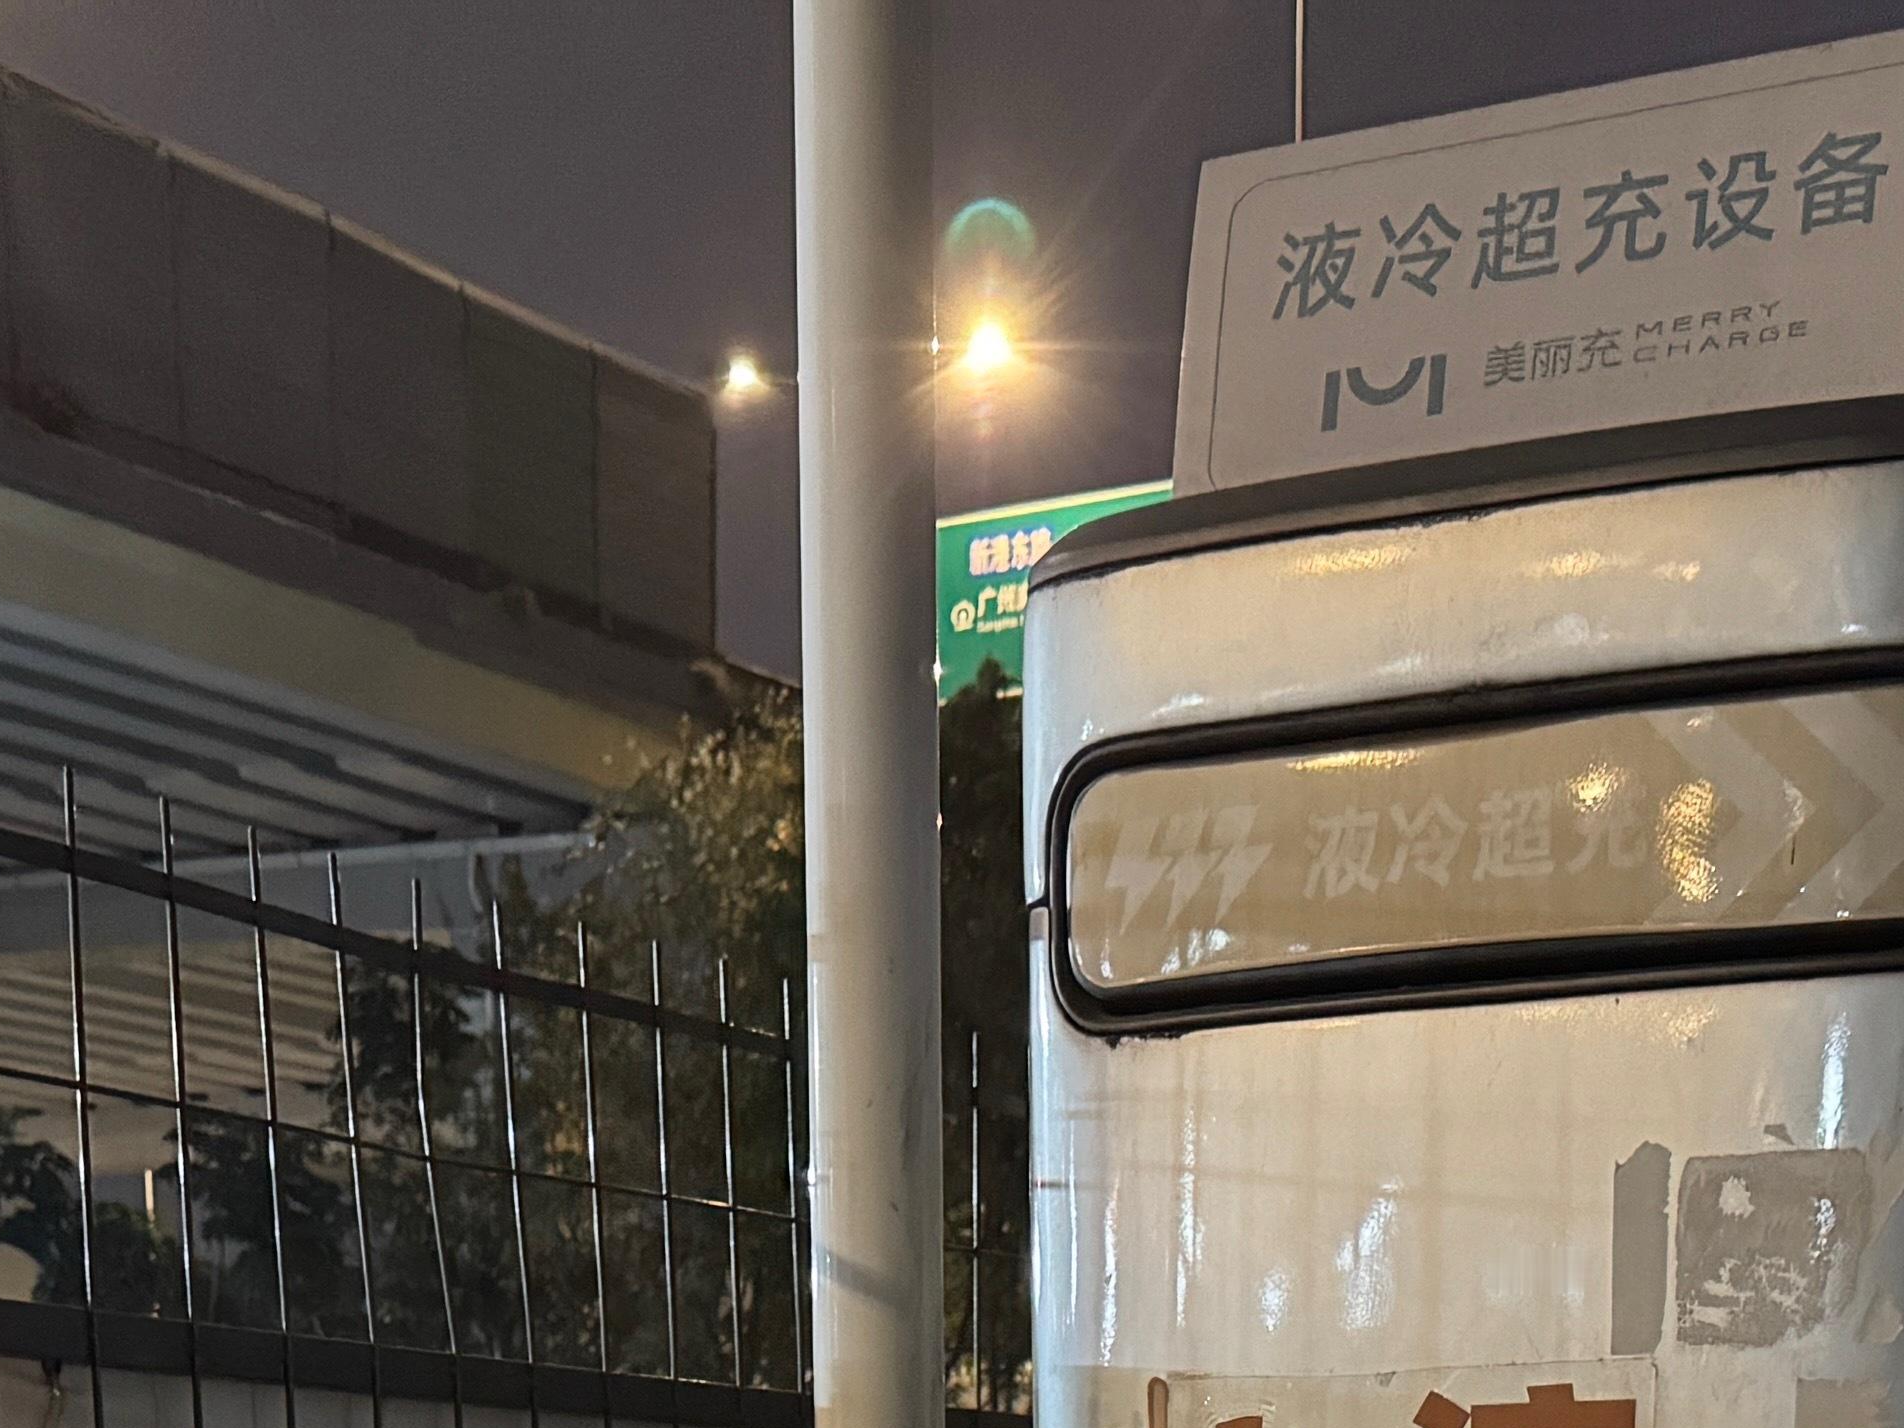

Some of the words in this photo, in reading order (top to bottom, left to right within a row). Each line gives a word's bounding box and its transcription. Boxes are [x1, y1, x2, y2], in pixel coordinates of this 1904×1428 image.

[1272, 131, 1888, 320] 液冷超充设备
[1633, 320, 1809, 362] CHARGE
[1635, 301, 1781, 340] MERRY
[1483, 328, 1622, 387] 美丽充
